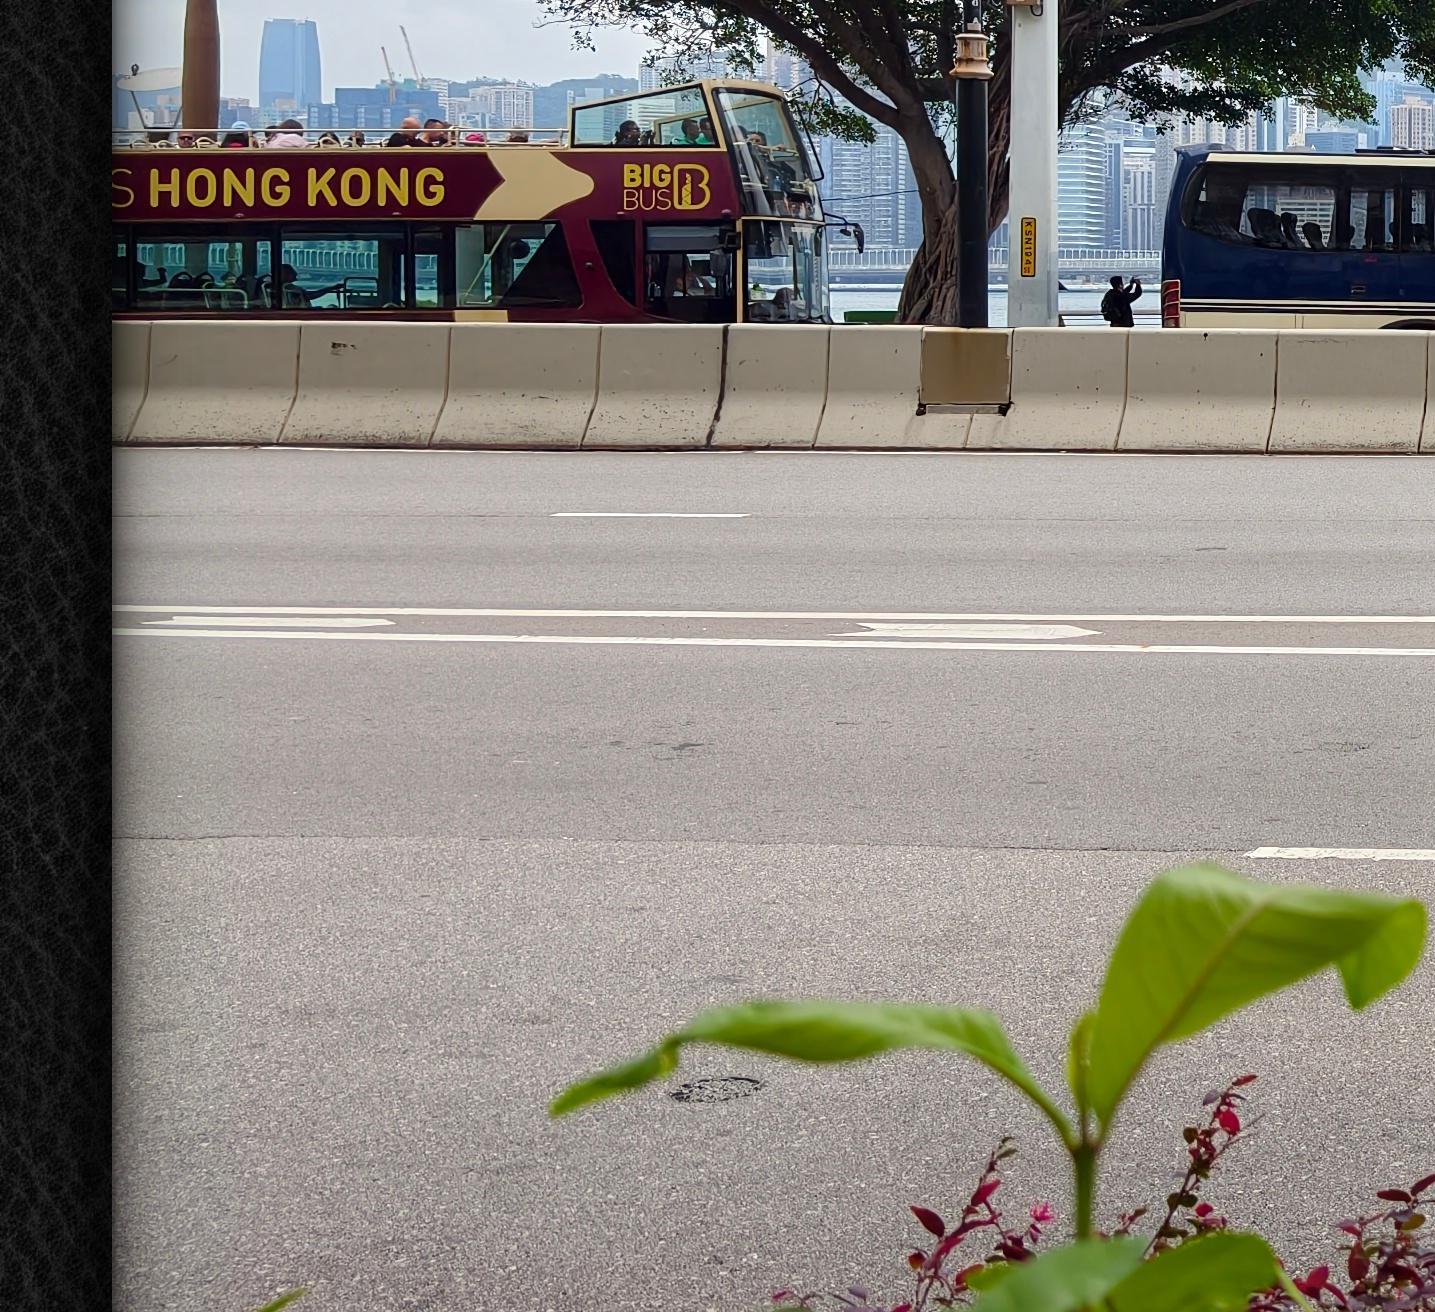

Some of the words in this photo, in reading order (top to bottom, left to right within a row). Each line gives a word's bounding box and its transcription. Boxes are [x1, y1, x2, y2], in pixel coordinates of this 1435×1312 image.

[150, 167, 291, 207] HONG
[307, 167, 445, 207] KONG
[623, 163, 672, 188] BIG
[623, 189, 672, 210] BUS
